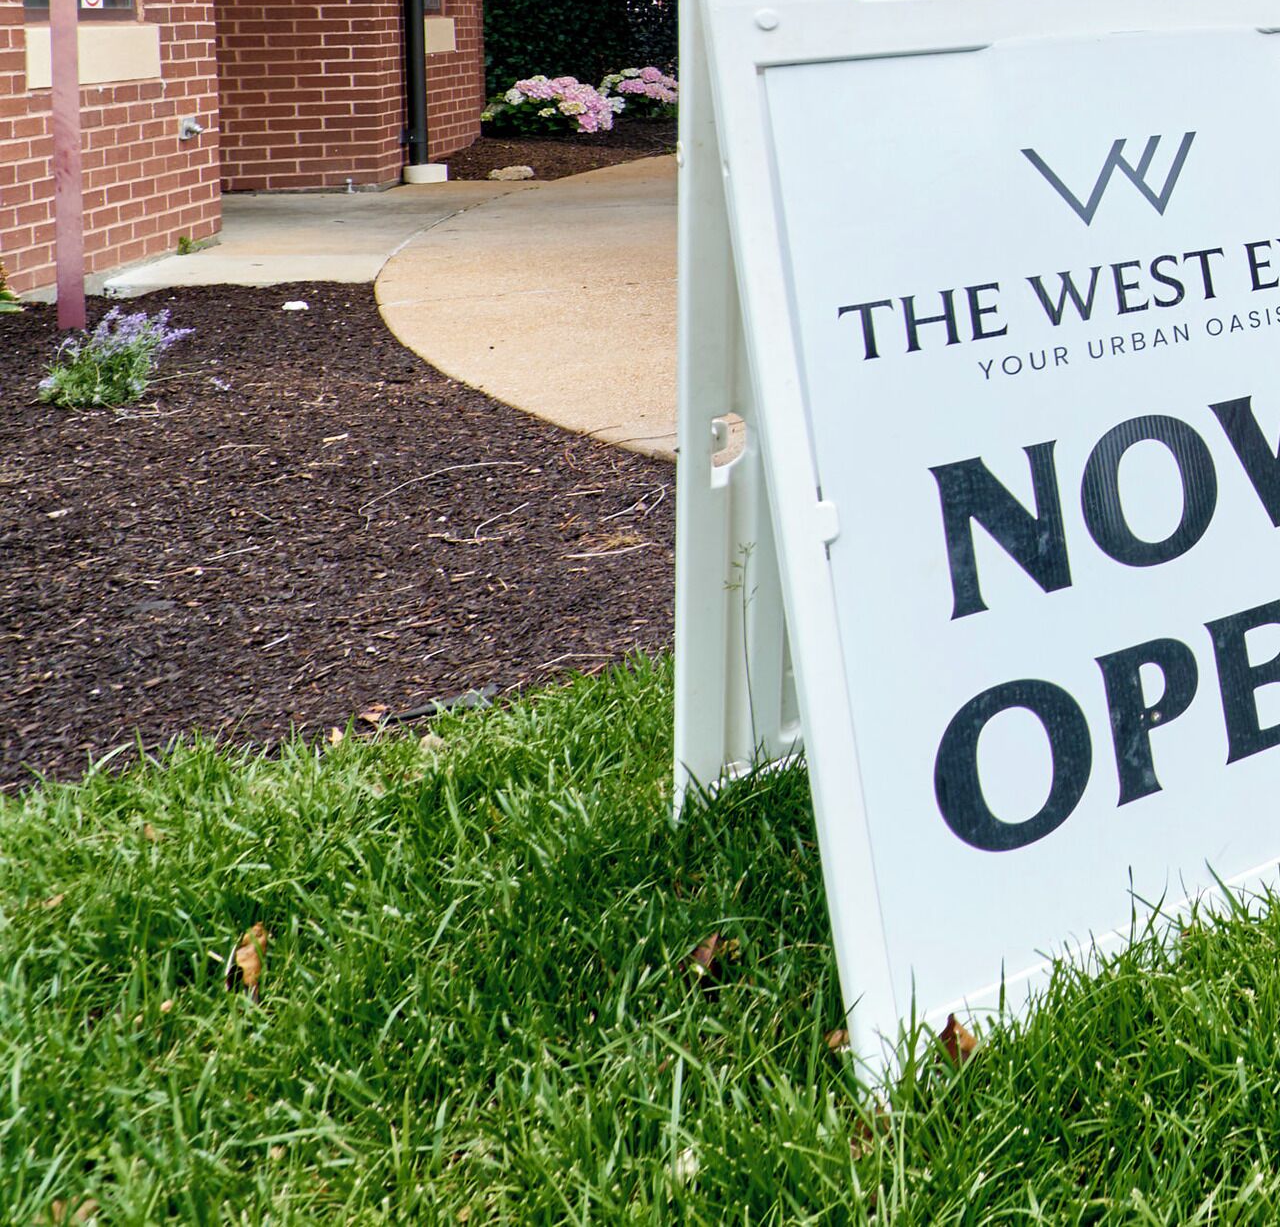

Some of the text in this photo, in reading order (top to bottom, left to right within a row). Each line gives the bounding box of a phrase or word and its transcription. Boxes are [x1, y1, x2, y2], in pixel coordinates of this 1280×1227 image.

[839, 283, 1007, 360] THE
[1026, 248, 1223, 326] WEST
[979, 347, 1068, 379] YOUR
[1088, 324, 1189, 358] URBAN
